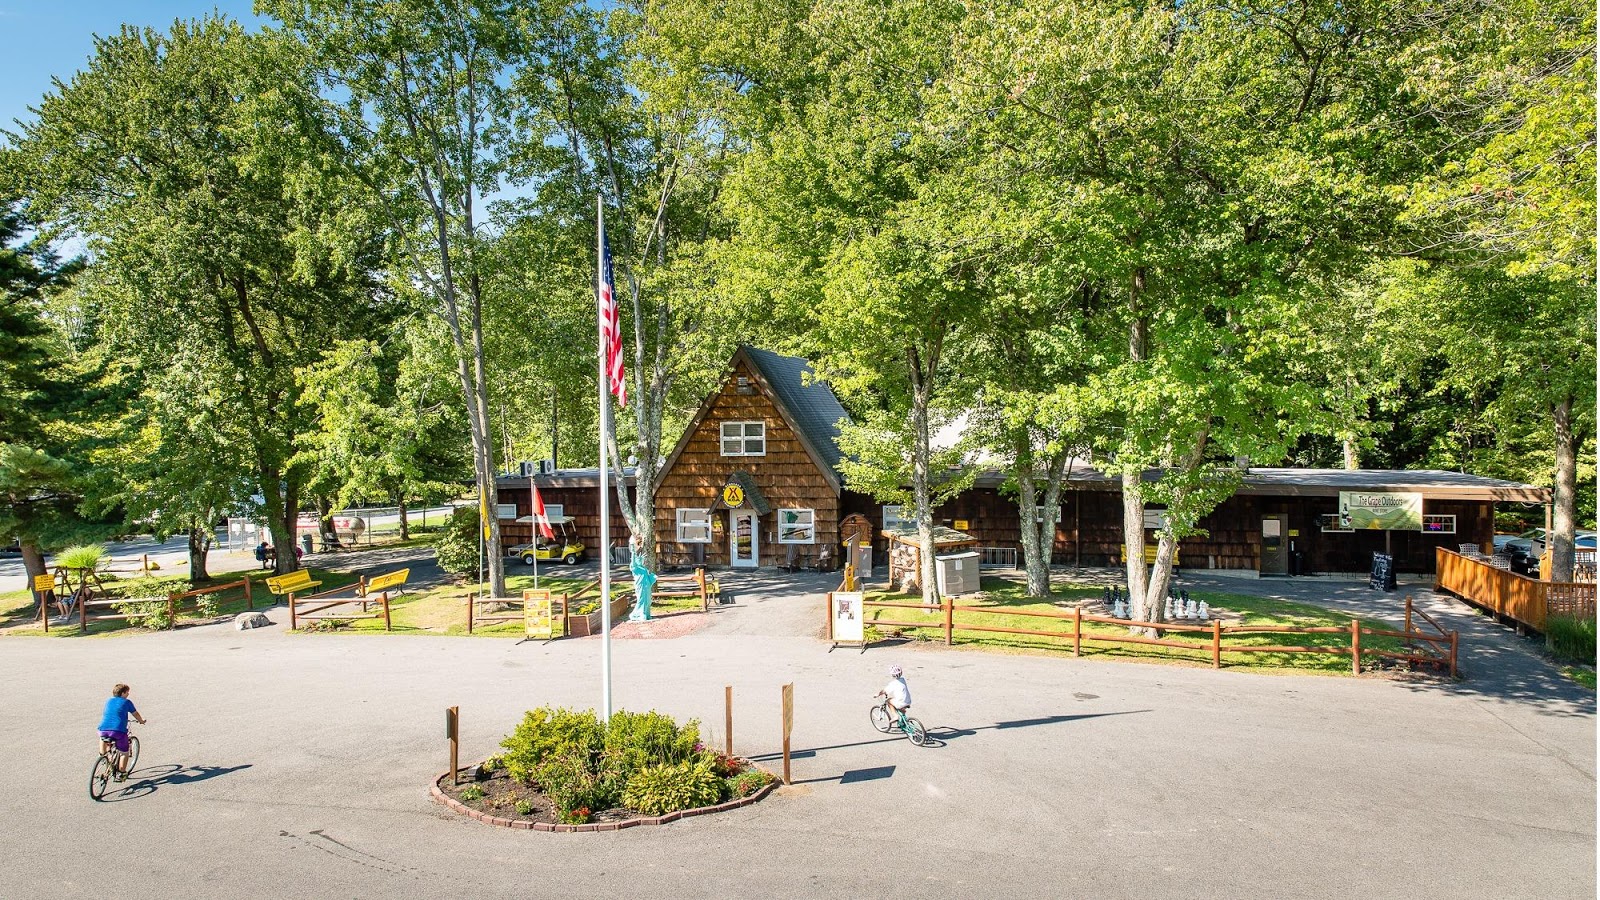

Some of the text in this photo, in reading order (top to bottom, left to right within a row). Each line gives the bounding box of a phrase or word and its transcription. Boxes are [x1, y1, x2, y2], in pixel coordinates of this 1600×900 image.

[1359, 496, 1403, 507] The Grape Outdoors
